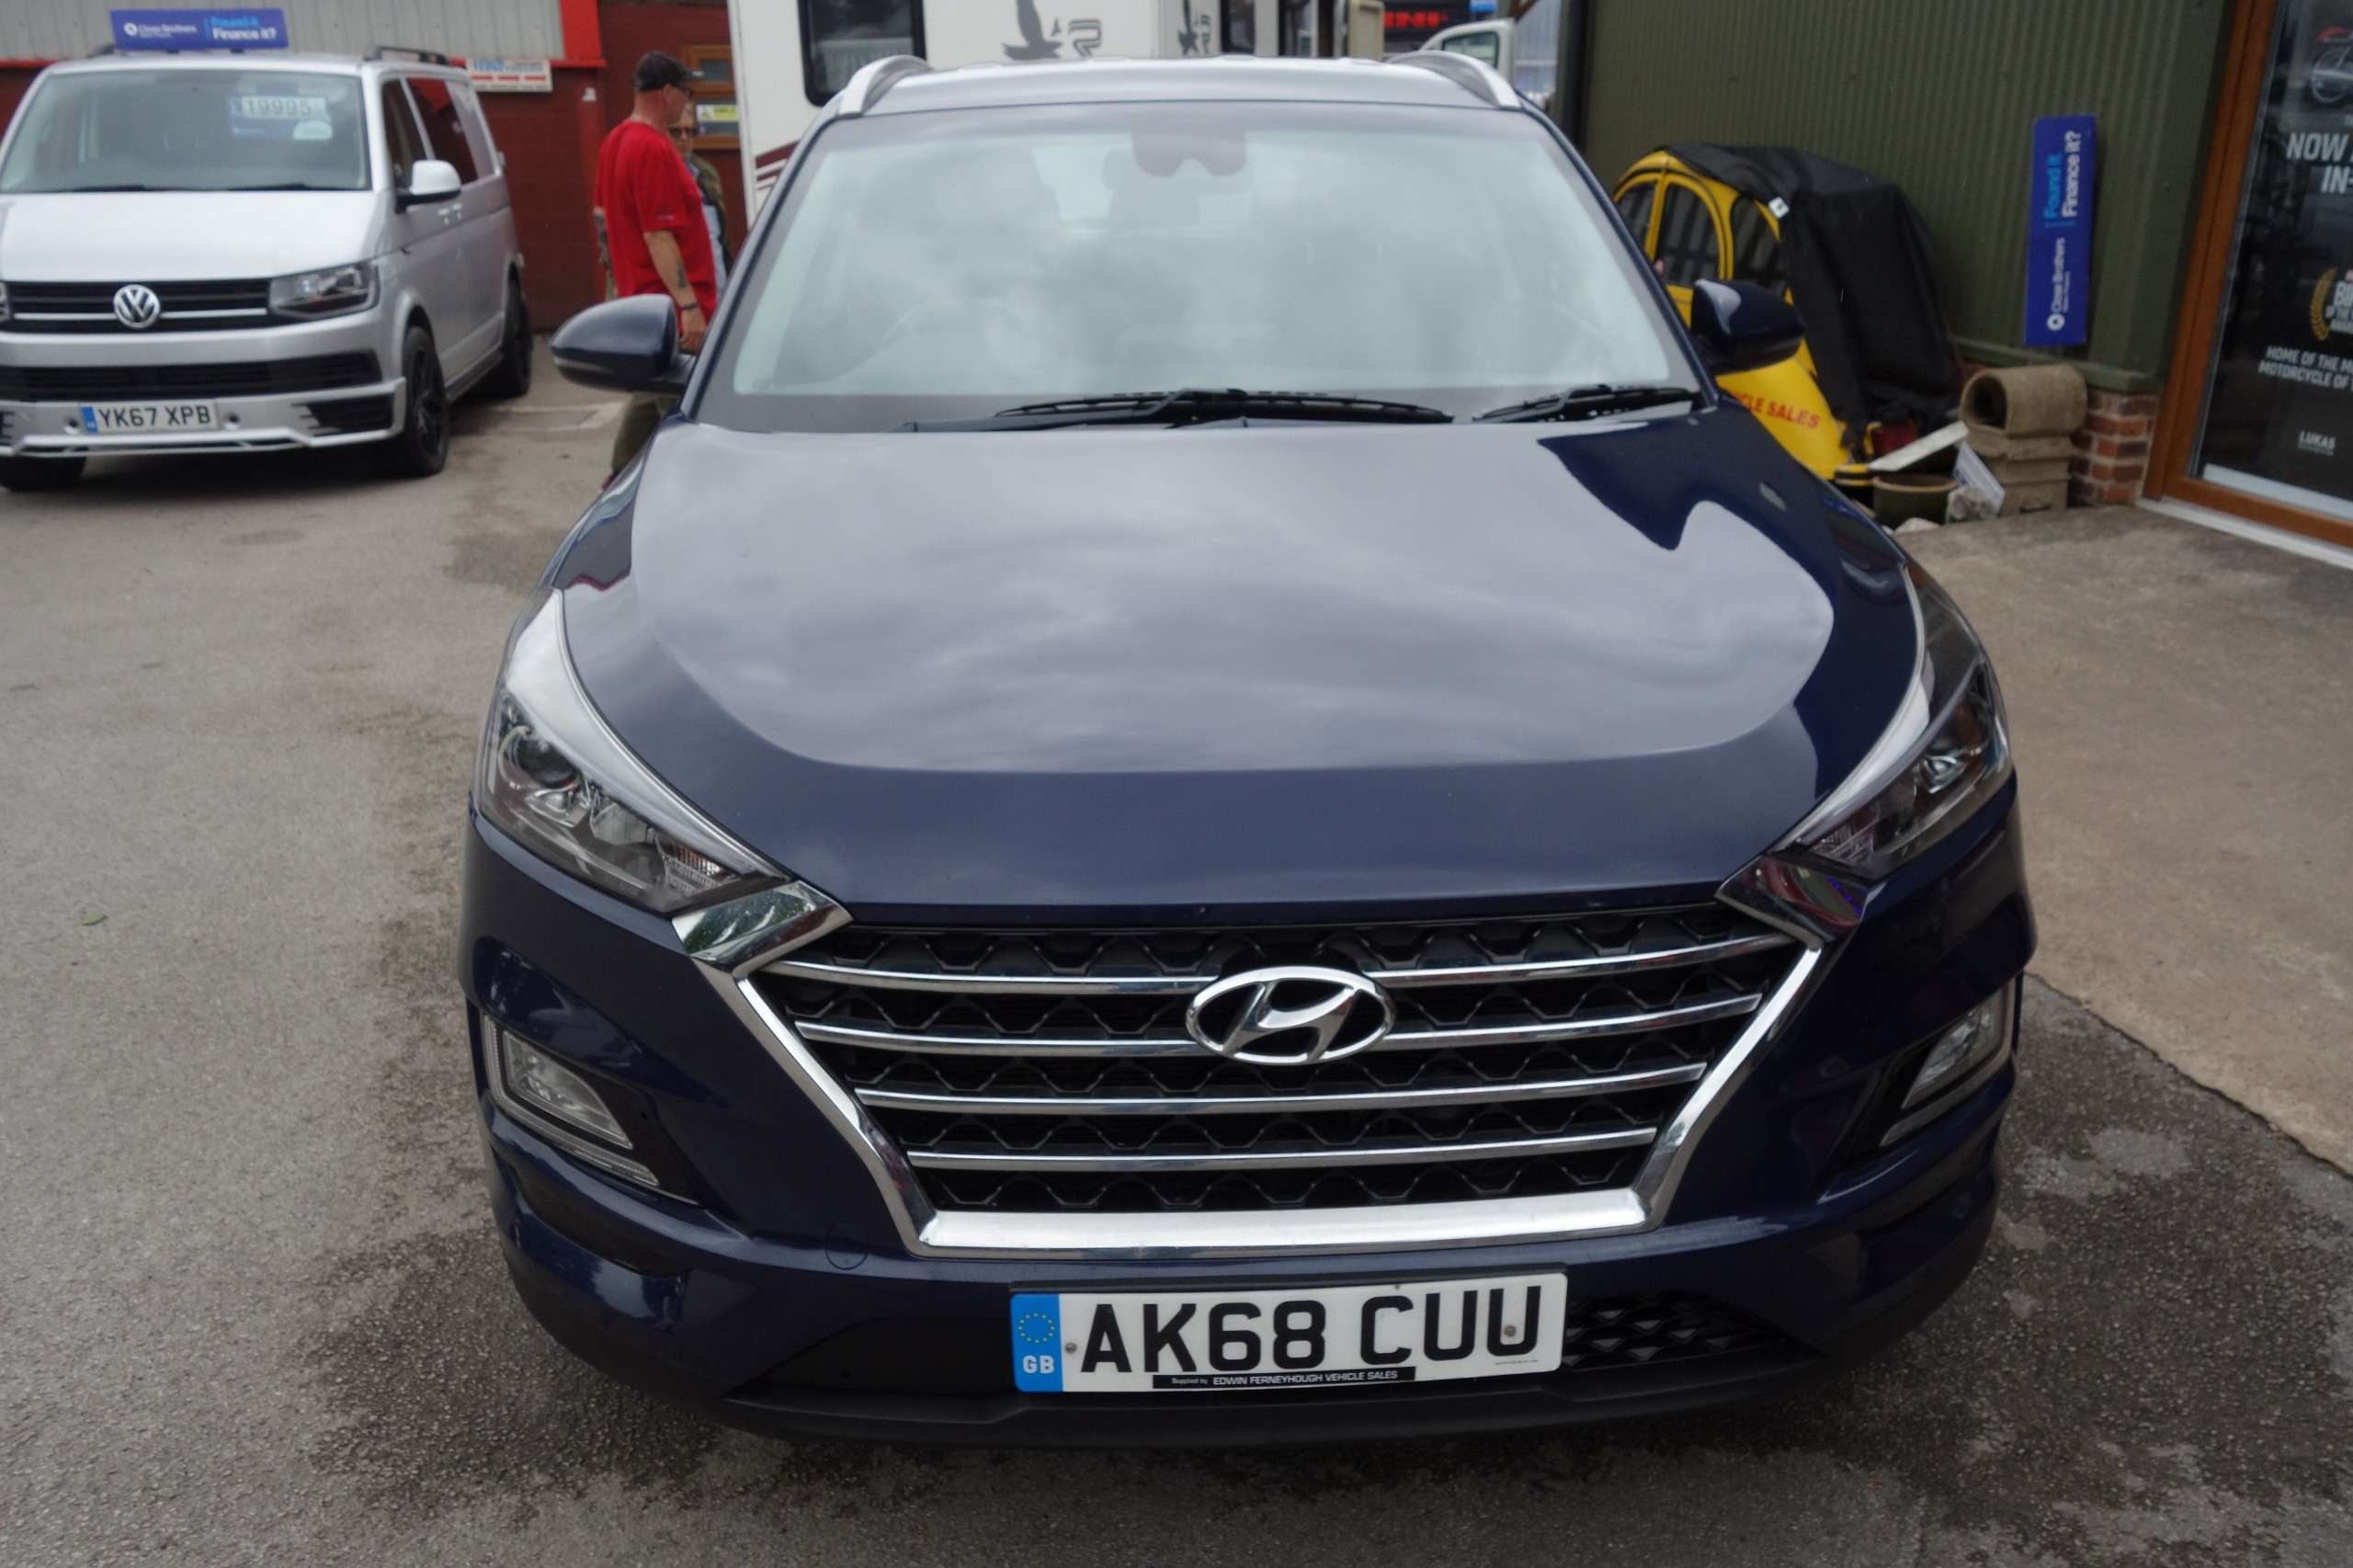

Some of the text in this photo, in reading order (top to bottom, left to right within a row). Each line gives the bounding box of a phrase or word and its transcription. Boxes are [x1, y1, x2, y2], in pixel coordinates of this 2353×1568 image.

[211, 28, 259, 40] Finance
[2286, 132, 2349, 161] NOW
[2062, 131, 2081, 218] Finance it?
[2052, 236, 2065, 283] Brothers
[2267, 345, 2301, 365] HOME
[2301, 350, 2317, 367] OF
[2317, 353, 2339, 372] THE
[2257, 359, 2349, 390] MOTORCYCLE OF
[98, 404, 211, 428] YK67 XPB
[1767, 400, 1820, 429] SALES
[2299, 430, 2336, 450] LUKAS
[1080, 1285, 1542, 1373] AK68 CUU
[1022, 1355, 1055, 1375] GB
[1212, 1376, 1247, 1386] EDWIN
[1249, 1374, 1324, 1385] FERNEYHOUGH
[1324, 1371, 1365, 1382] VEHICLE
[1367, 1369, 1398, 1381] SALES
